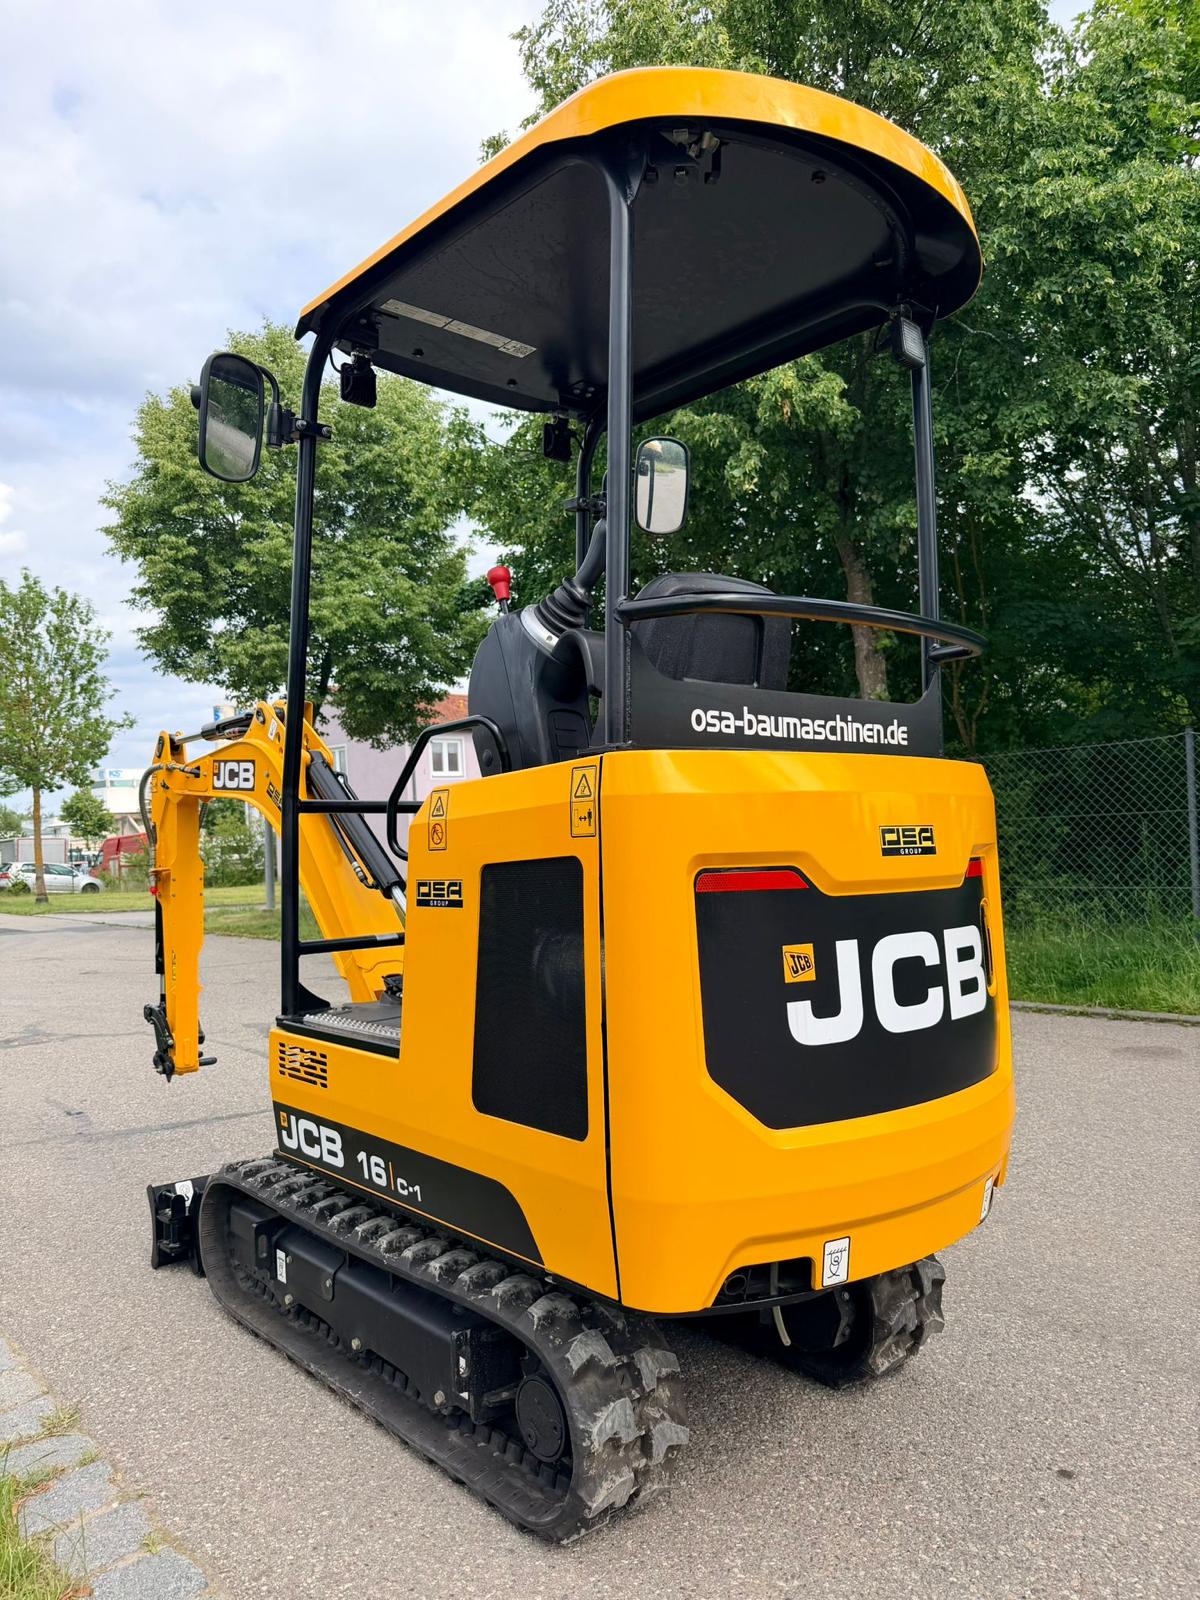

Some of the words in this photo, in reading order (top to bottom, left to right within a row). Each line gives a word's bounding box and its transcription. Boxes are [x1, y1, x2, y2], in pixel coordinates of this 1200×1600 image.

[690, 706, 908, 746] osa-baumaschinen.de
[213, 761, 255, 789] JCB
[899, 847, 922, 856] GROUP
[429, 899, 449, 907] GROUP
[790, 953, 812, 976] JCB
[787, 925, 987, 1046] JCB
[281, 1114, 345, 1168] JCB
[357, 1151, 387, 1188] 16
